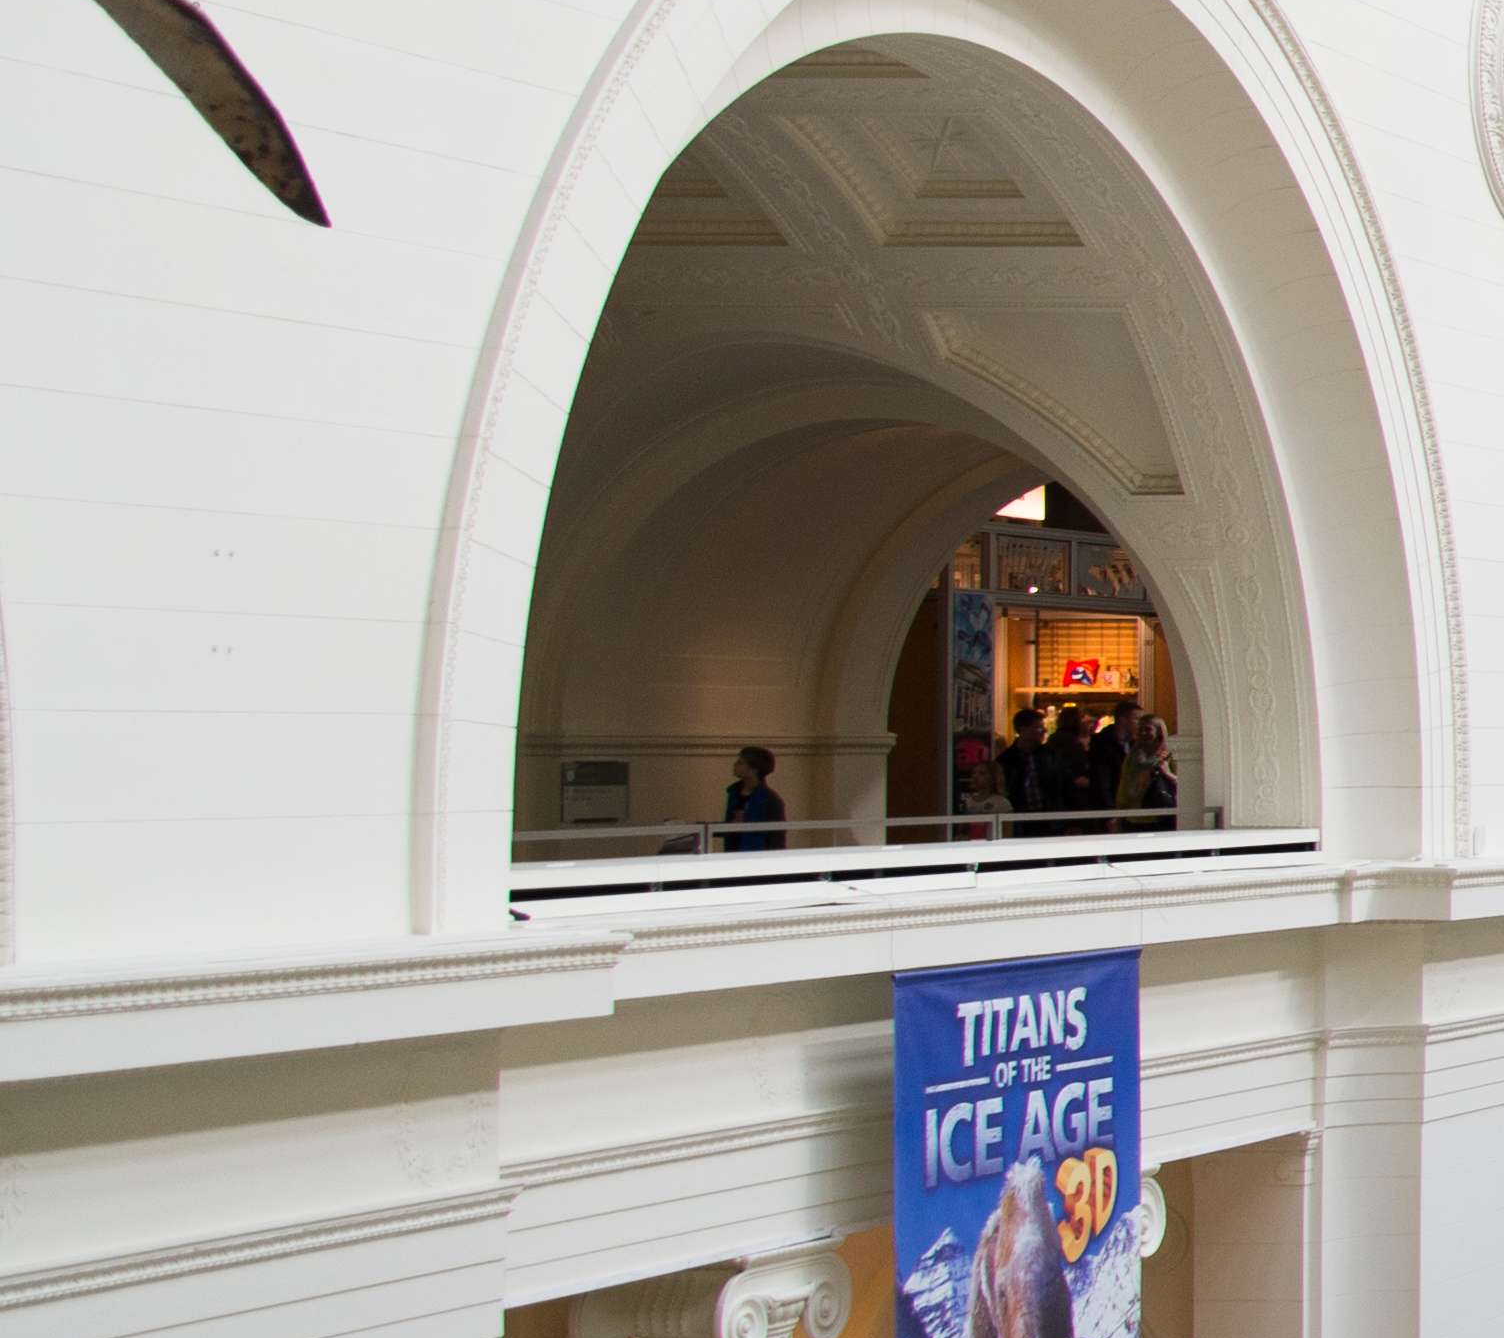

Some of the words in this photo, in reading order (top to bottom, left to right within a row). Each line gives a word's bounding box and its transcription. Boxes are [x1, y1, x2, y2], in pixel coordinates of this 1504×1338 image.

[957, 986, 1088, 1067] TITANS
[994, 1060, 1018, 1088] OF
[1021, 1055, 1051, 1083] THE
[924, 1096, 1004, 1189] ICE
[1019, 1077, 1113, 1162] AGE
[1056, 1147, 1118, 1263] 3D
